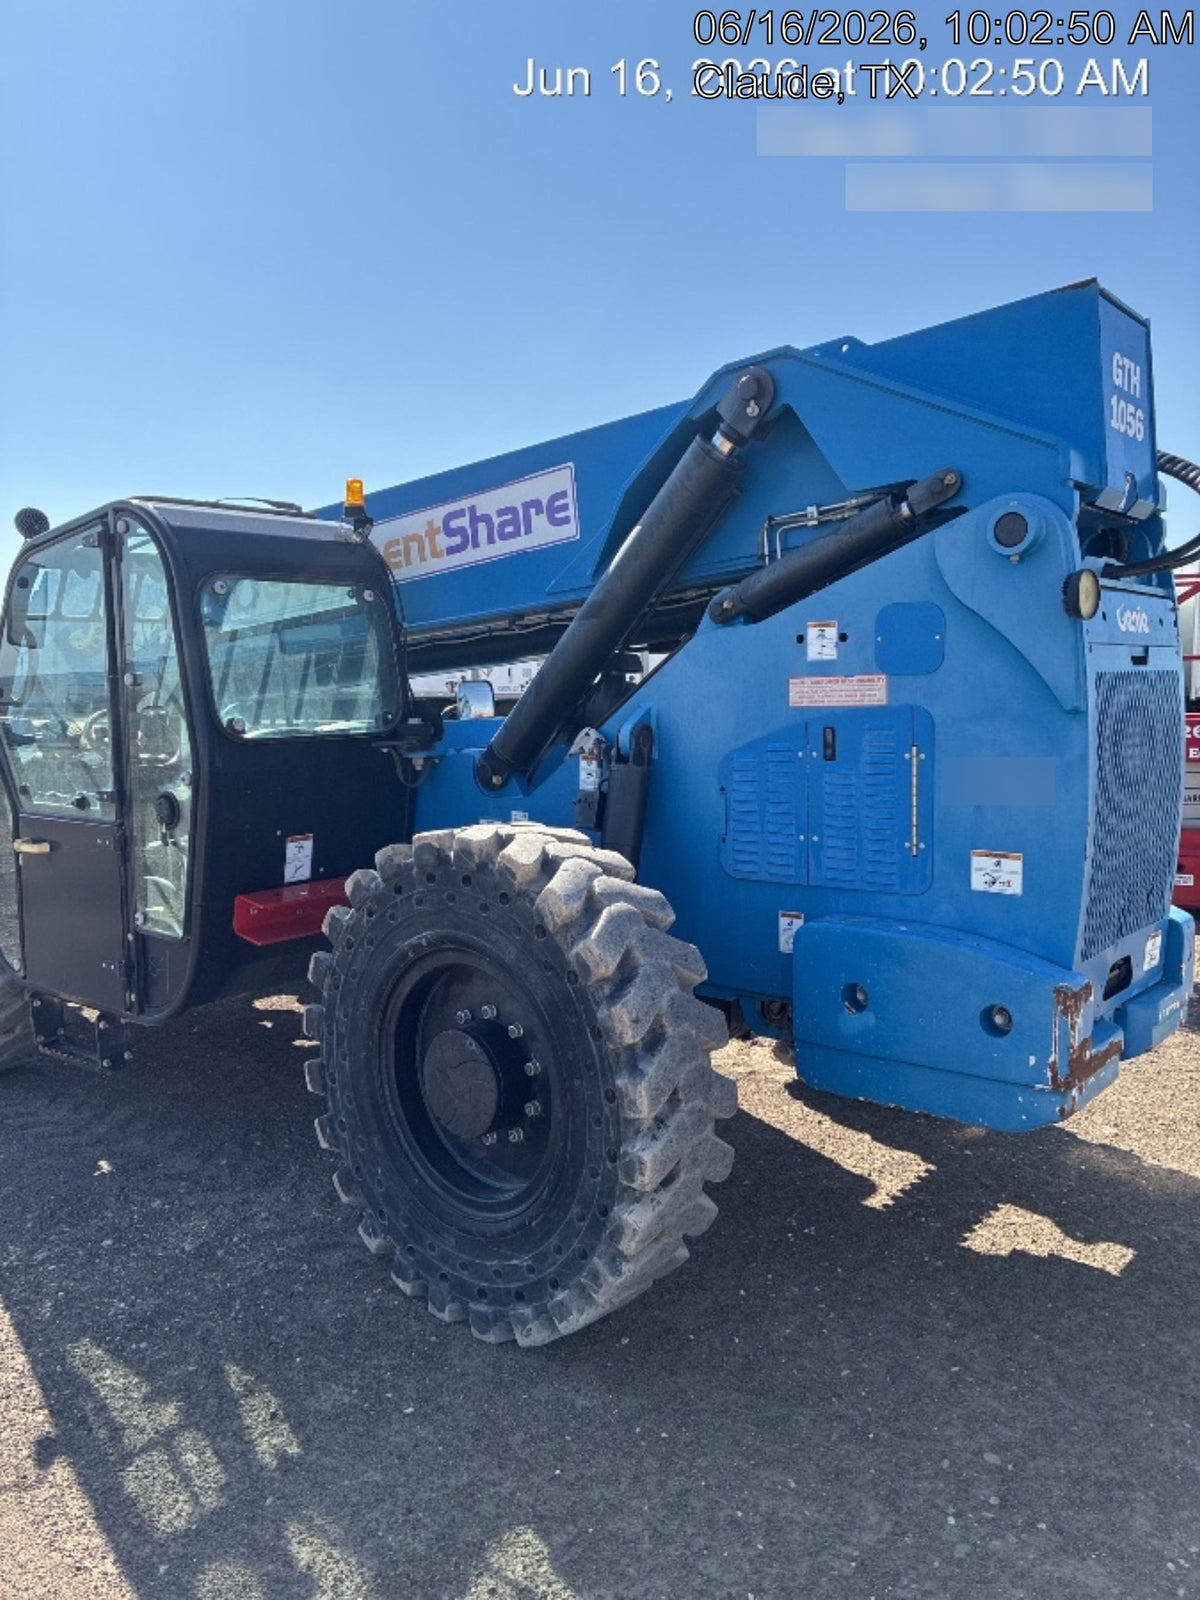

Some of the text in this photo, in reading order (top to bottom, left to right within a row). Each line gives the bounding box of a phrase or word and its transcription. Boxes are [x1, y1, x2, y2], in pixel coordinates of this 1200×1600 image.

[1112, 351, 1141, 399] GTH
[1110, 394, 1145, 442] 1056
[383, 489, 571, 570] entShare
